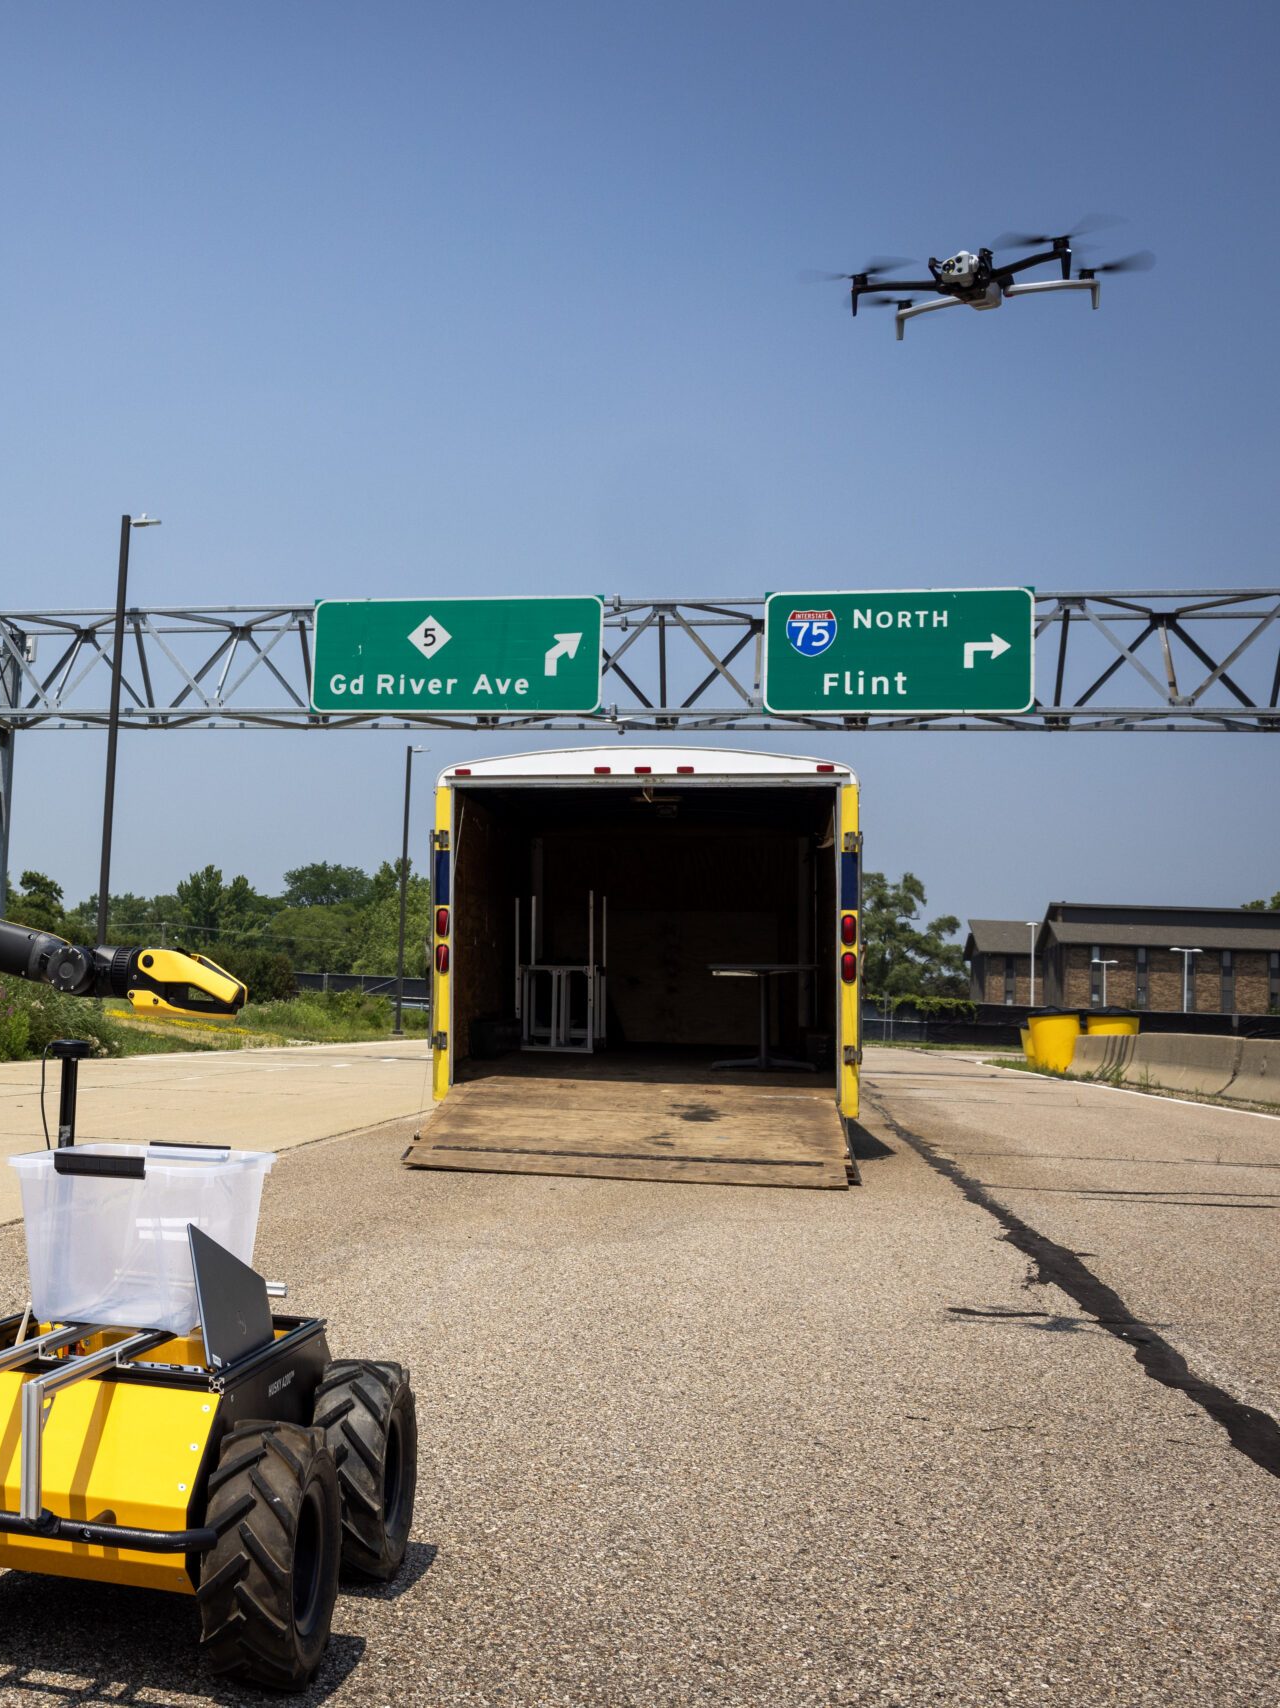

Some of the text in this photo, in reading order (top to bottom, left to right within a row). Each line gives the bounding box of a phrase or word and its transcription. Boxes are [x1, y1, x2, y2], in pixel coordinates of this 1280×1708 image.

[853, 609, 949, 629] NORTH
[423, 628, 436, 647] 5
[791, 622, 830, 647] 75
[329, 674, 529, 695] Gd River Ave
[823, 671, 907, 695] Flint
